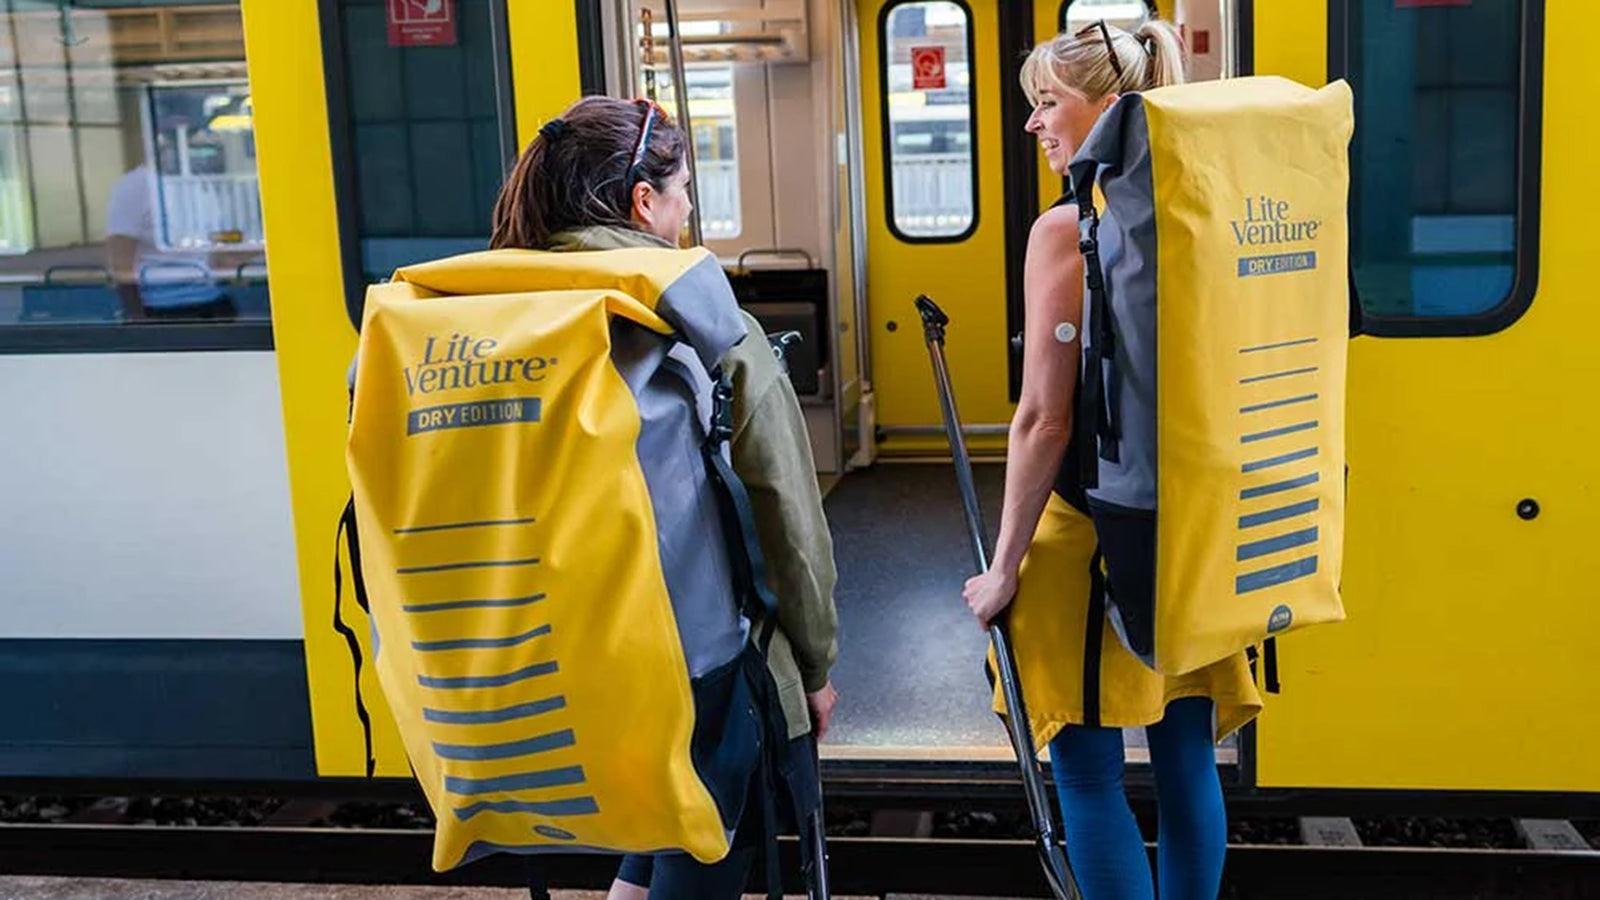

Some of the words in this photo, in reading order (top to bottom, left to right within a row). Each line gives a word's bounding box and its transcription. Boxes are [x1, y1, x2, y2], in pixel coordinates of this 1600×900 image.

[1246, 195, 1289, 222] Lite
[1231, 219, 1319, 246] Venture
[1249, 259, 1273, 274] DRY
[1275, 255, 1308, 271] EDITION
[418, 333, 498, 366] Lite
[404, 356, 549, 396] Venture
[418, 410, 457, 429] DRY
[460, 402, 524, 424] EDITION
